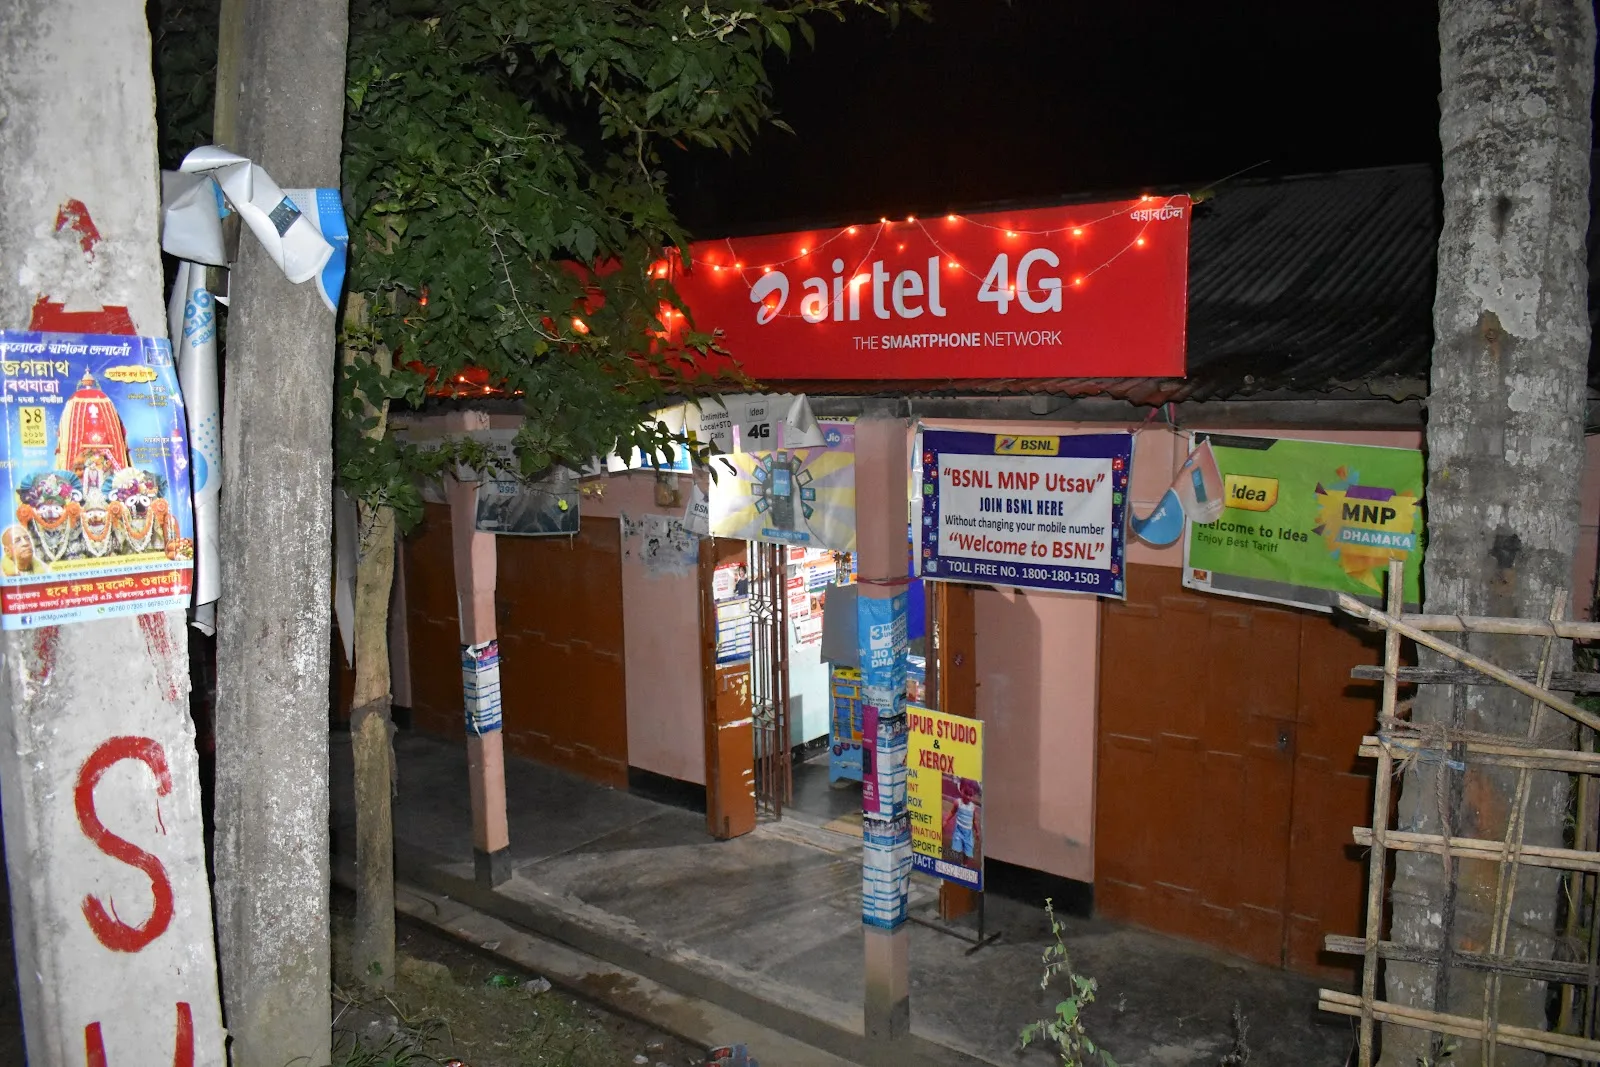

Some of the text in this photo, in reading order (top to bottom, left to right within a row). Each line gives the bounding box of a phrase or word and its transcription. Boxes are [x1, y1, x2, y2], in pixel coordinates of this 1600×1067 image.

[800, 248, 1063, 324] airtel 4G
[852, 330, 1063, 350] THE SMARTPHONE NETWORK
[24, 408, 42, 424] ১৪
[700, 411, 729, 422] Unlimited
[700, 420, 732, 431] Local+STD
[747, 423, 770, 439] 4G
[826, 432, 840, 442] Jio
[1020, 439, 1054, 451] BSNL
[998, 471, 1040, 490] MNP
[979, 497, 1064, 516] JOIN BSNL HERE
[1341, 503, 1396, 525] MNP
[945, 514, 1105, 535] Without changing your mobile number
[1259, 523, 1274, 539] to
[1278, 525, 1309, 543] Idea
[1197, 532, 1279, 553] Enjoy Best Tariff
[1342, 528, 1412, 548] DHAMAKA
[1031, 540, 1048, 558] to
[949, 561, 1100, 585] TOLL FREE NO. 1800-180-1503
[871, 625, 883, 641] 3
[871, 649, 889, 659] JIO
[936, 719, 977, 745] STUDIO
[933, 739, 941, 750] &
[918, 749, 954, 774] XEROX
